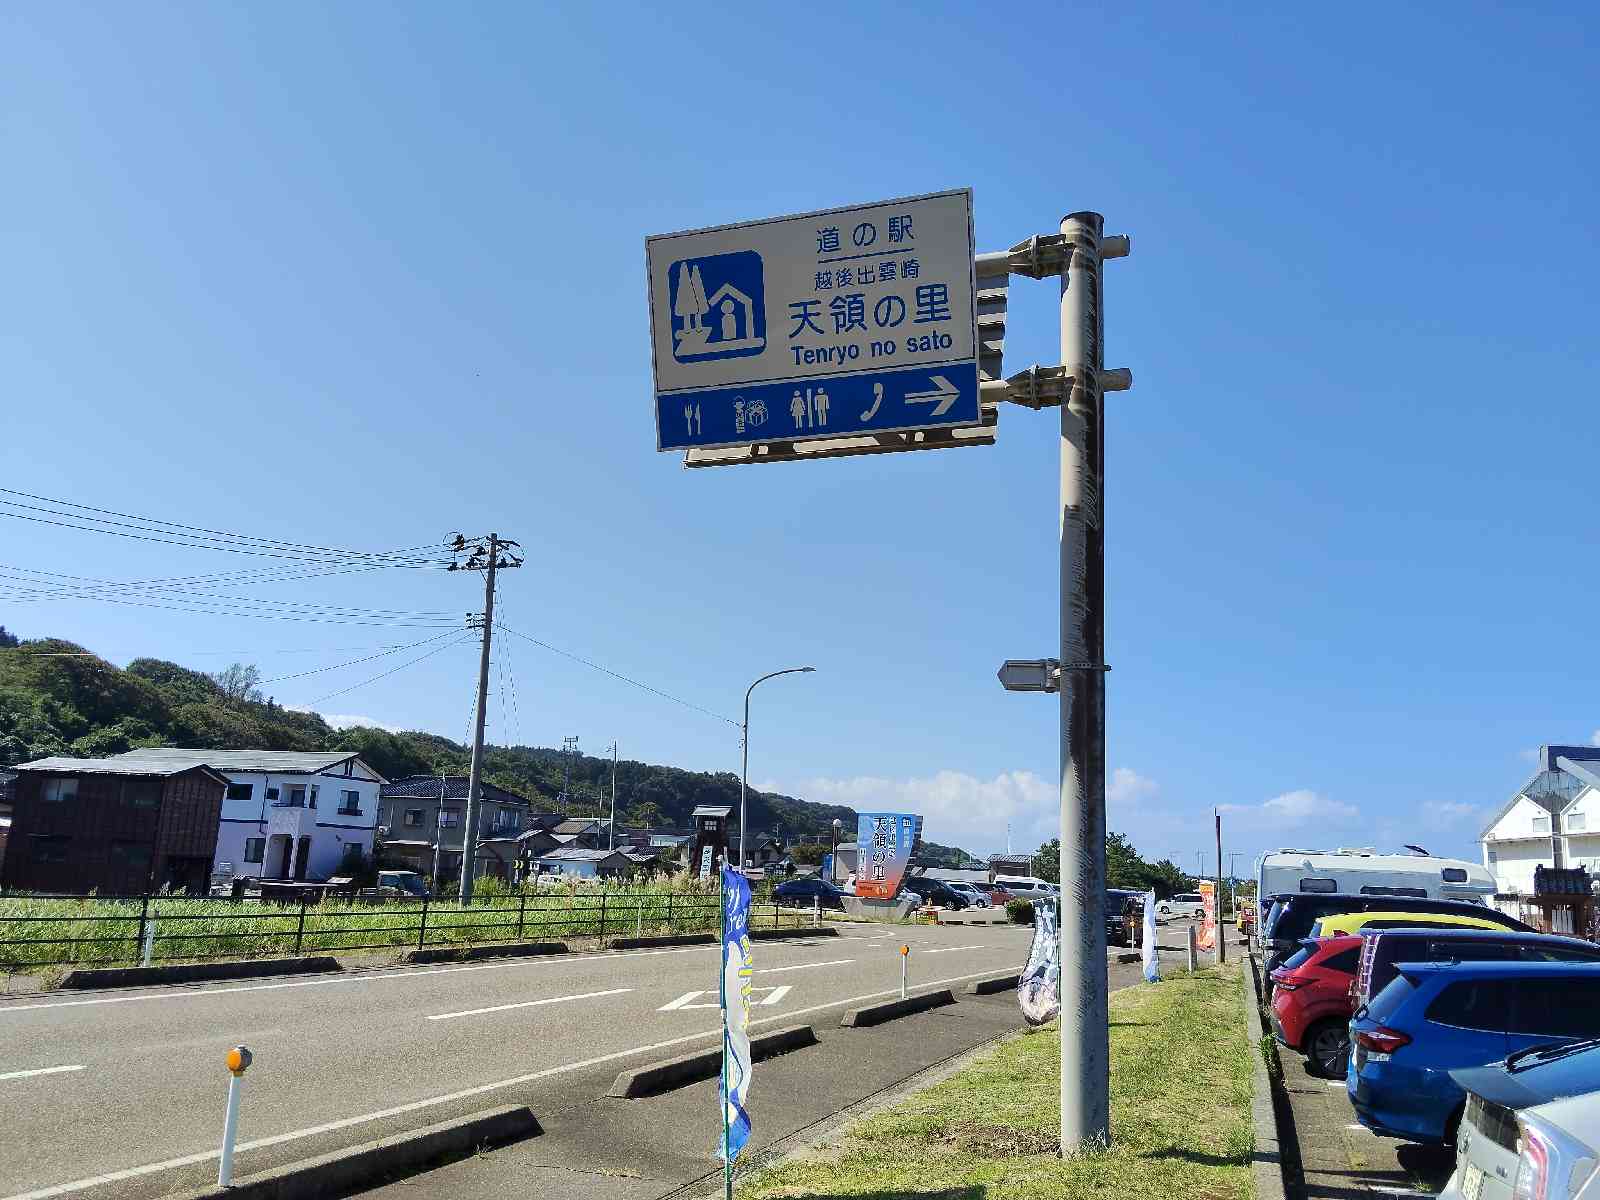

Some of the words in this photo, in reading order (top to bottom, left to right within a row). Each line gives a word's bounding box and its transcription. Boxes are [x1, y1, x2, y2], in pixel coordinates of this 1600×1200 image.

[816, 214, 915, 254] 道の駅
[814, 257, 921, 291] 越後出雲崎
[788, 283, 952, 338] 天領の里
[790, 343, 860, 366] Tenryo
[871, 340, 897, 357] no
[906, 330, 953, 353] sato
[872, 816, 888, 881] 天領の里
